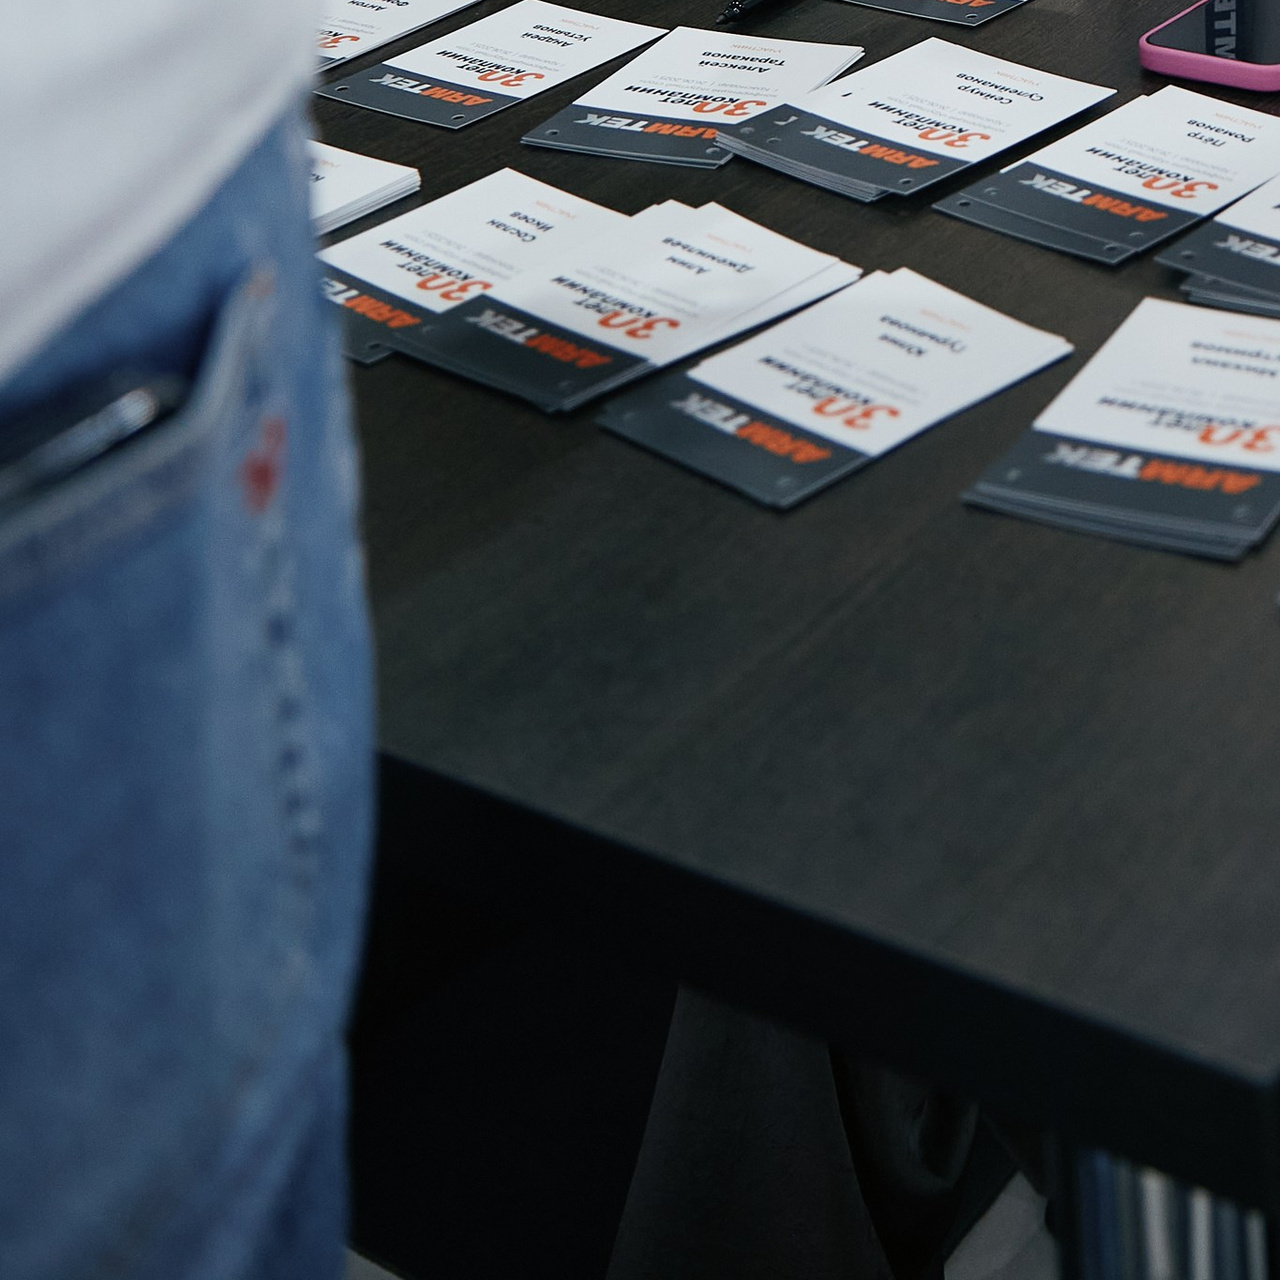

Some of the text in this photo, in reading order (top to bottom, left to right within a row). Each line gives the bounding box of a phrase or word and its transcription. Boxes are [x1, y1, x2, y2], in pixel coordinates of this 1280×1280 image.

[345, 0, 388, 11] Антон
[519, 32, 573, 47] Андрей
[530, 24, 593, 42] Устьянов
[434, 49, 526, 75] компании
[696, 60, 770, 74] Алексей
[700, 51, 787, 66] Тараканов
[368, 72, 492, 107] ARMTEK
[455, 63, 546, 88] 30 лет
[952, 73, 1047, 101] Сулейманов
[623, 84, 739, 105] компании
[657, 96, 767, 117] 30 лет
[954, 85, 1015, 104] Сеймур
[573, 112, 720, 139] ARMTEK
[866, 101, 969, 134] компании
[1183, 119, 1256, 142] Романов
[799, 124, 939, 171] ARMTEK
[890, 117, 992, 150] 30 лет
[1183, 131, 1227, 147] Пётр
[1084, 146, 1194, 184] компании
[1112, 164, 1220, 201] 30 лет
[1017, 172, 1166, 224] ARMTEK
[484, 218, 538, 242] Сослан
[507, 211, 555, 232] Икоев
[378, 240, 474, 281] компании
[663, 255, 709, 275] Алим
[395, 261, 494, 303] 30 лет
[550, 275, 656, 319] компании
[572, 297, 683, 341] 30 лет
[462, 308, 612, 369] ARMTEK
[758, 355, 872, 406] компании
[783, 379, 902, 431] 30 лет
[1097, 395, 1254, 432] компании
[669, 392, 831, 464] ARMTEK
[1045, 442, 1260, 494] ARMTEK
